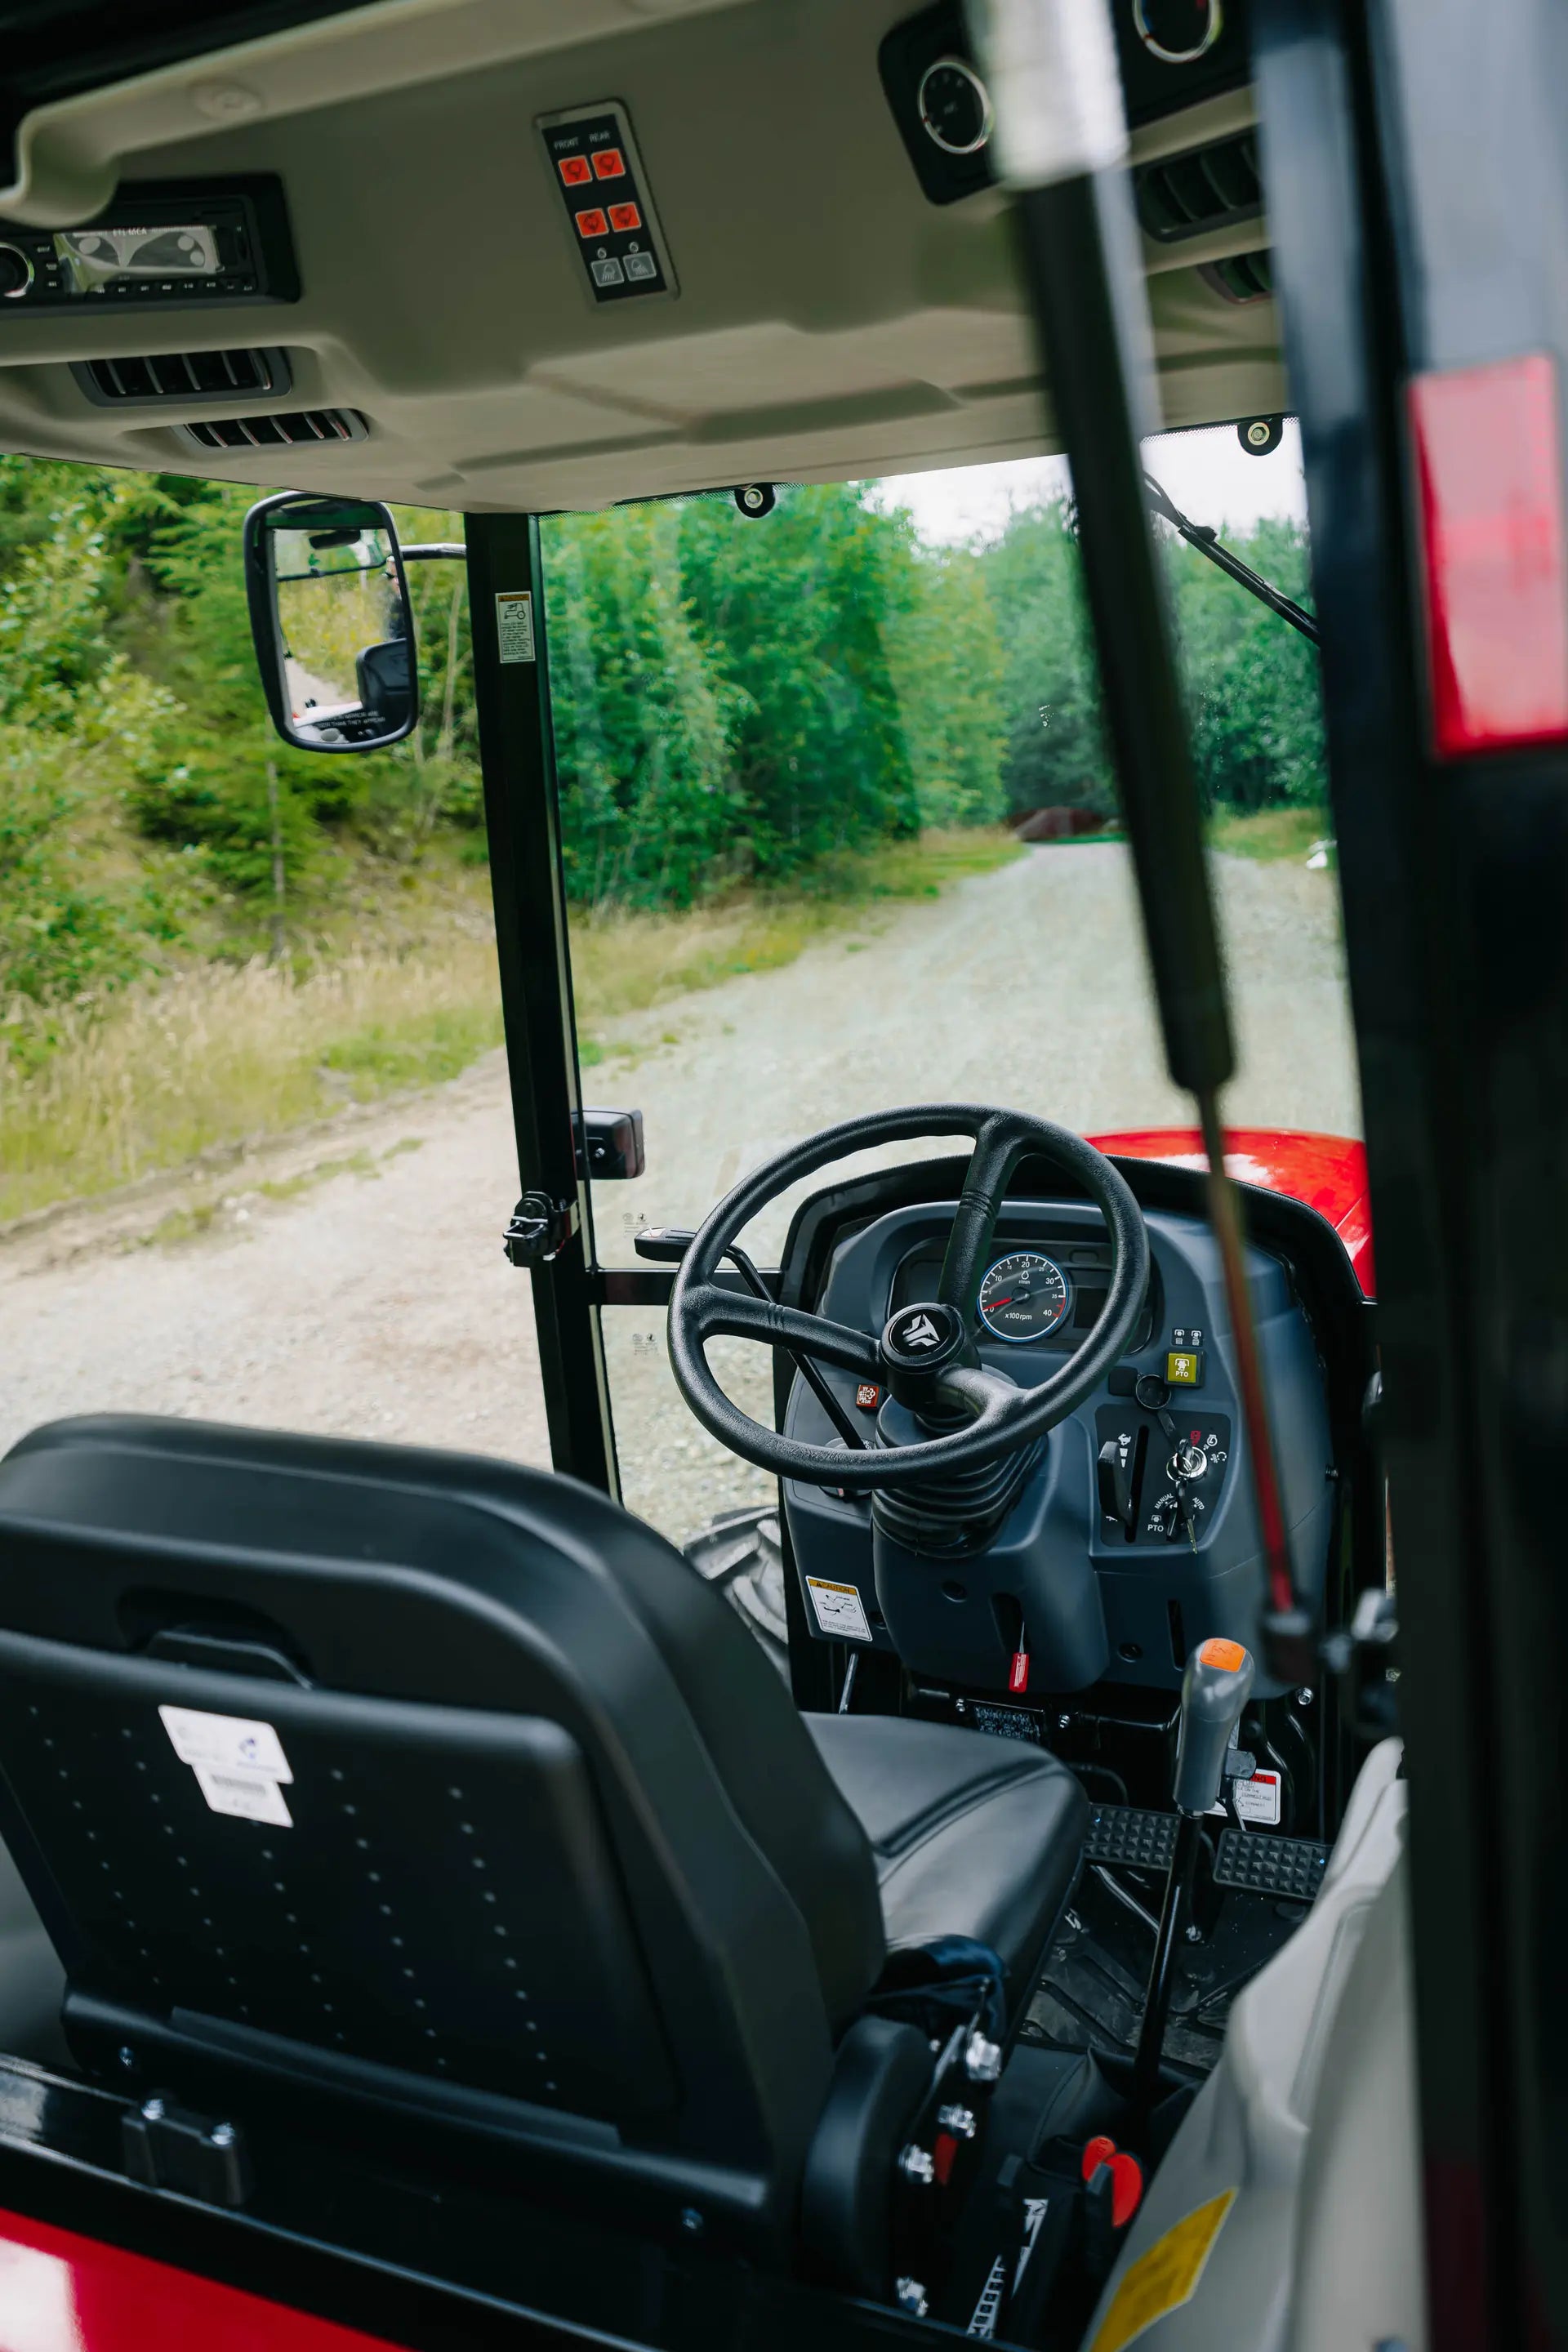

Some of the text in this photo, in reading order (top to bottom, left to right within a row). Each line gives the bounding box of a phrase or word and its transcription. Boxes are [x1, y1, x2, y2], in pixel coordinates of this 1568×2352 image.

[554, 131, 611, 150] FRONT REAR
[1155, 1493, 1174, 1509] MANUAL
[1192, 1497, 1205, 1510] AUTO
[1147, 1524, 1164, 1532] PTO
